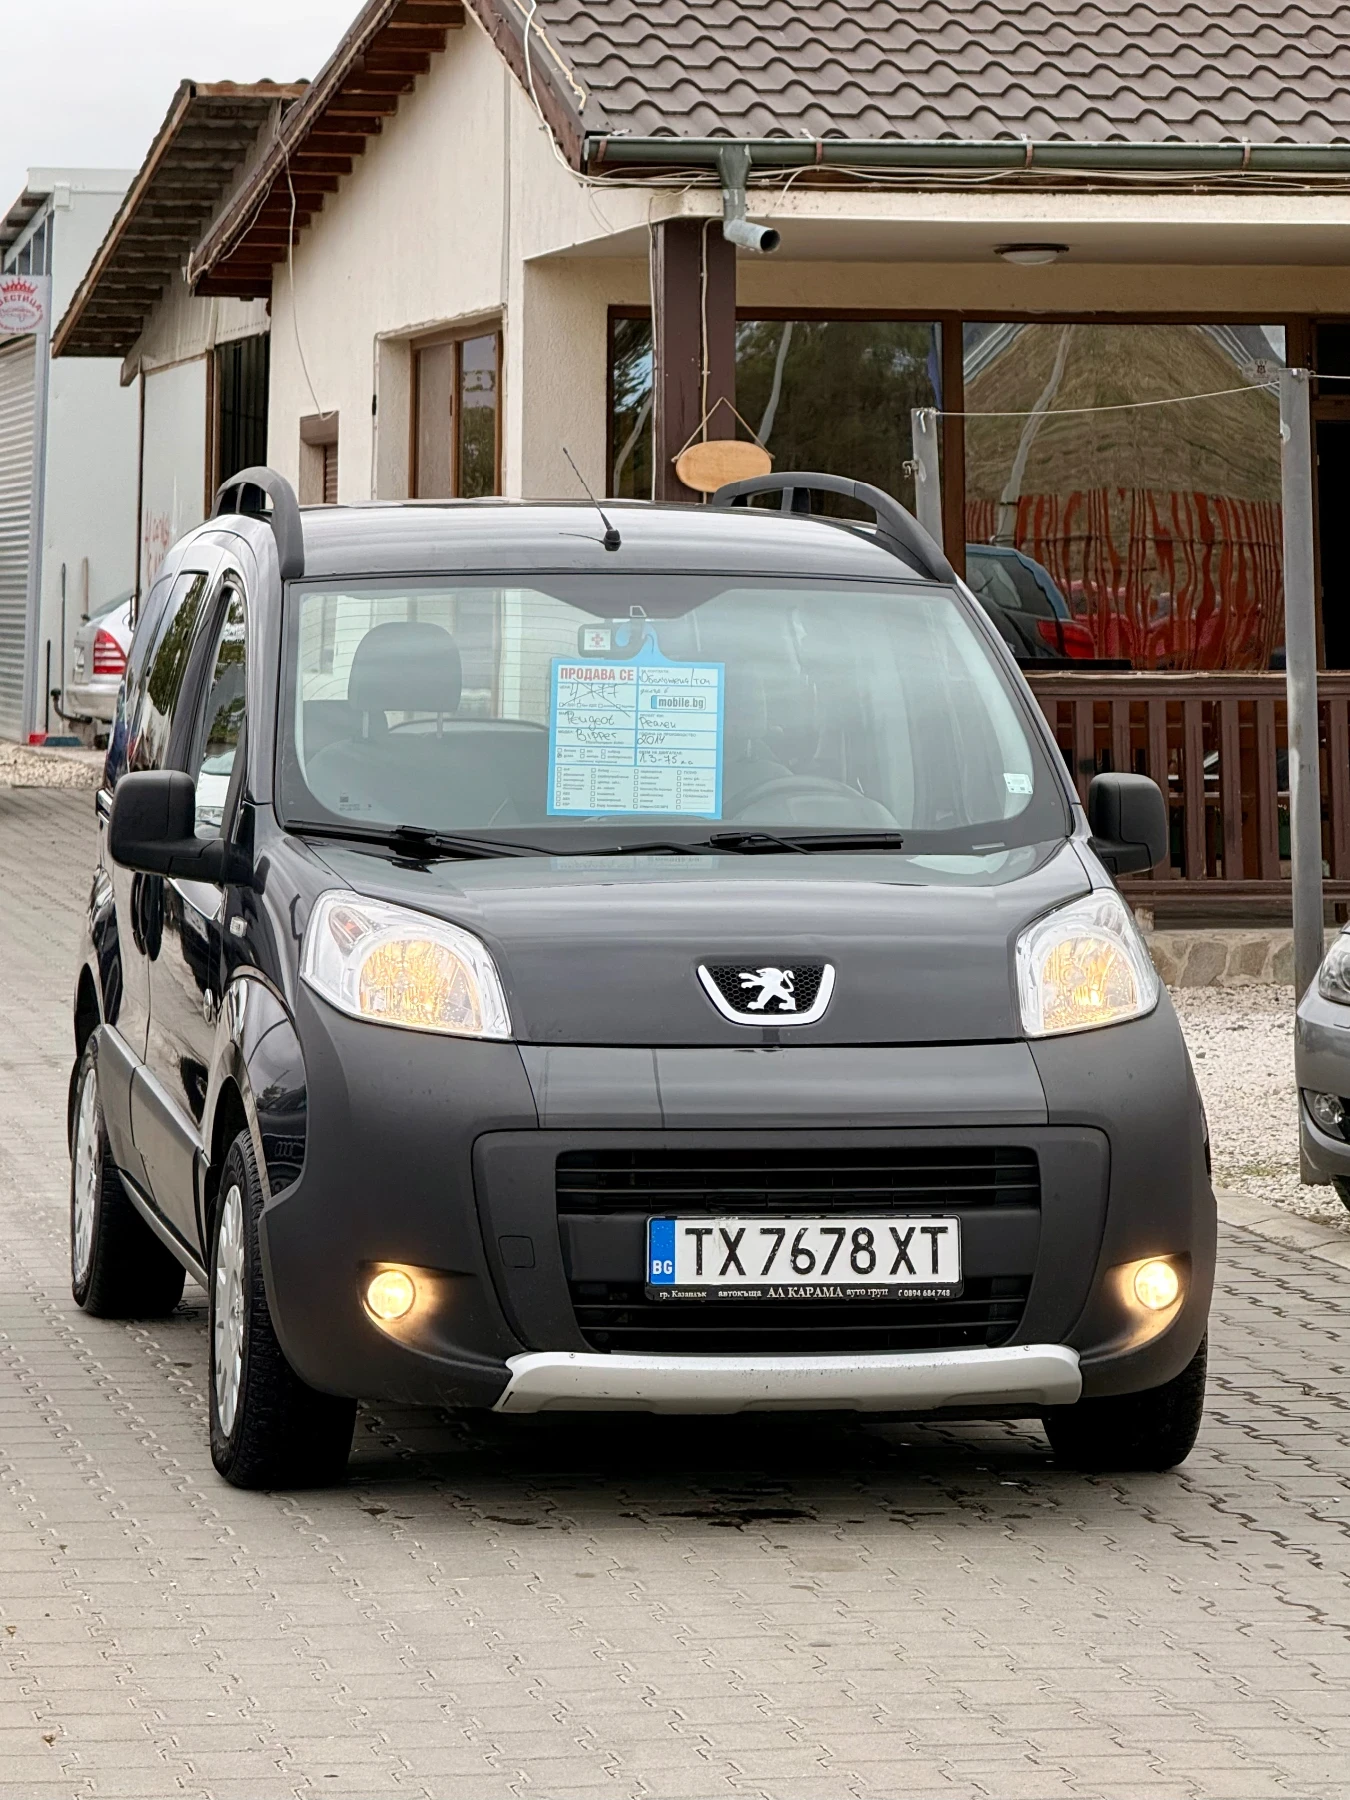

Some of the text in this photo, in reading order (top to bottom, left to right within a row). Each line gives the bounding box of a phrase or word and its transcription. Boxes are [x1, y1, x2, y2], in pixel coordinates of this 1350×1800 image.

[0, 294, 42, 311] ЕСТИЦА
[560, 667, 634, 682] ПРОДАВА СЕ
[658, 697, 704, 709] mobile.bg
[566, 711, 615, 731] Peugeot
[652, 1260, 673, 1275] BG
[787, 1287, 844, 1298] КАРАМА
